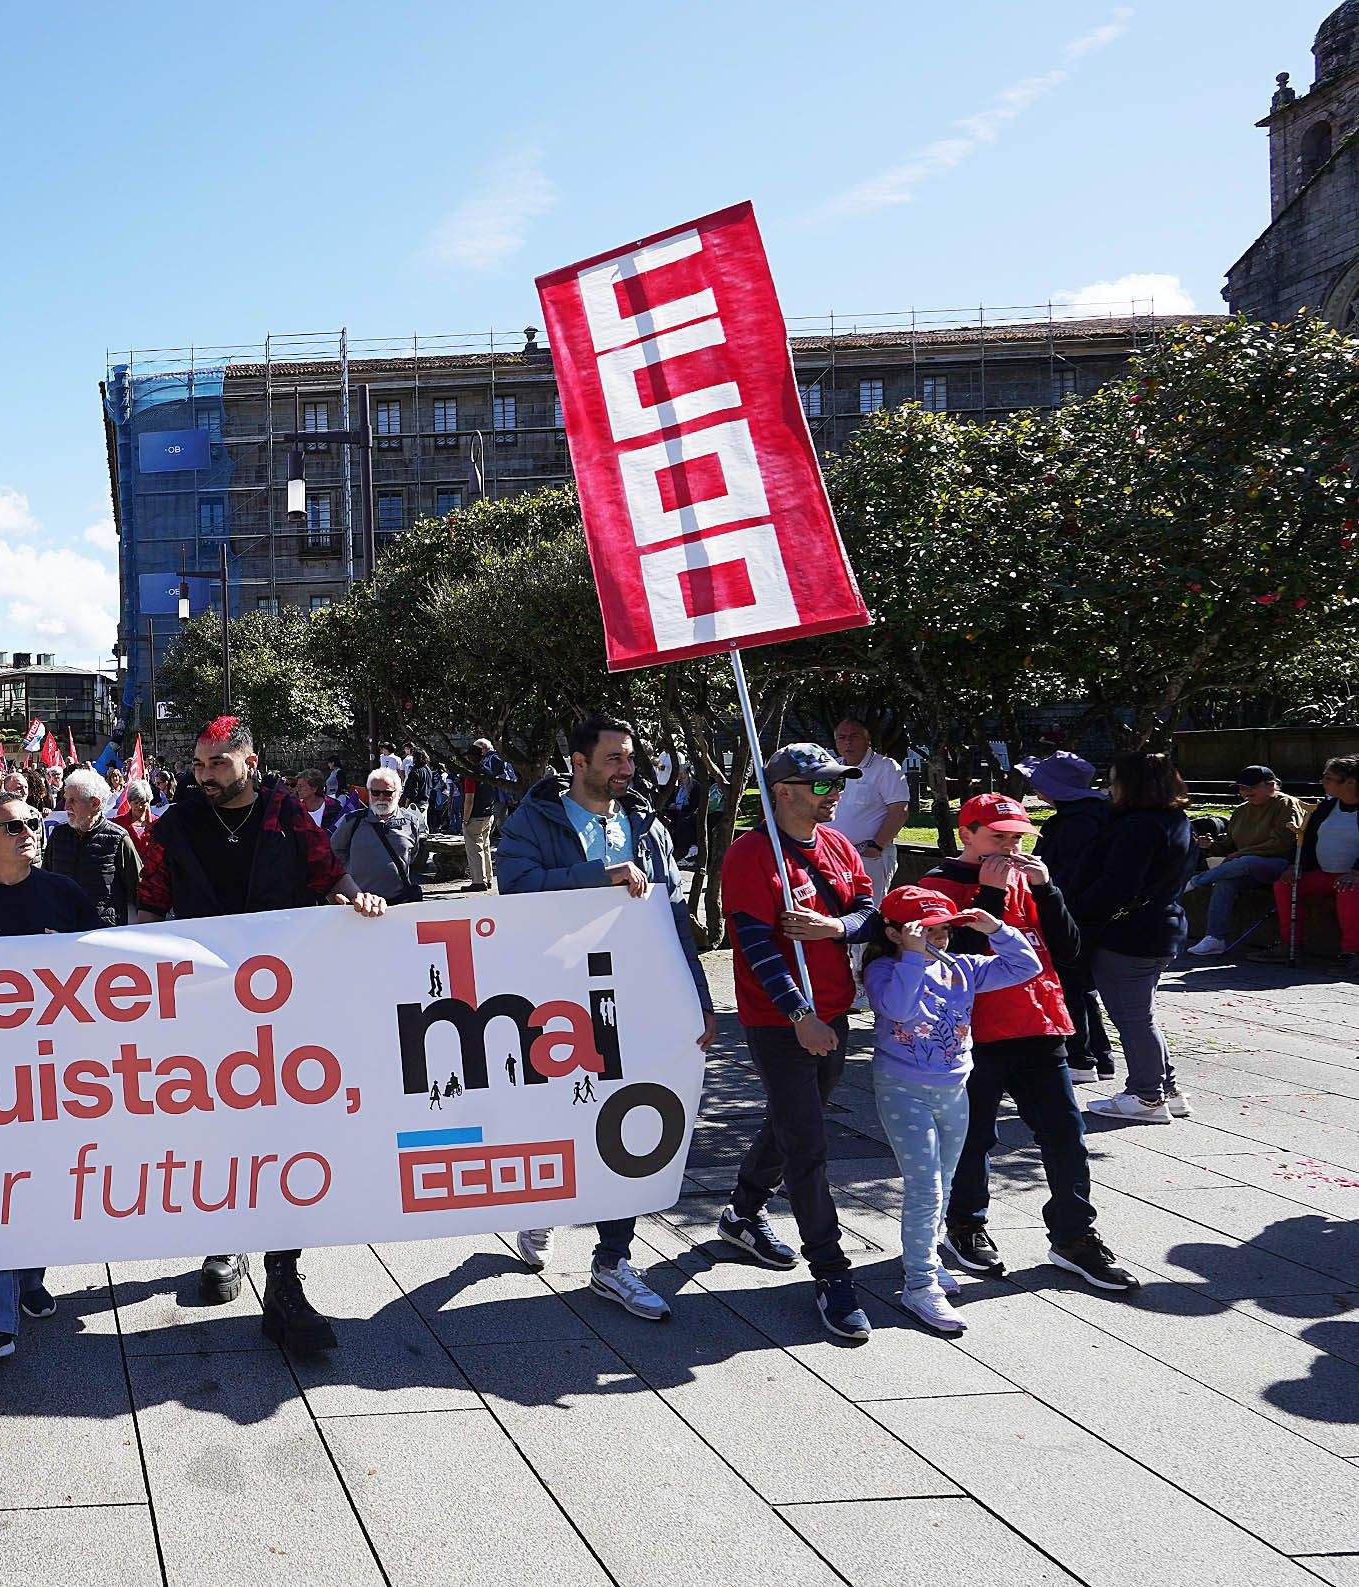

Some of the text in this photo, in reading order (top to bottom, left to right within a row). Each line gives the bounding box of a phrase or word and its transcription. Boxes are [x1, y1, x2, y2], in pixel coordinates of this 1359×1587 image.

[577, 228, 800, 651] CCOO
[234, 954, 293, 1014] o
[69, 1143, 333, 1221] futuro
[412, 1153, 564, 1200] CCOO
